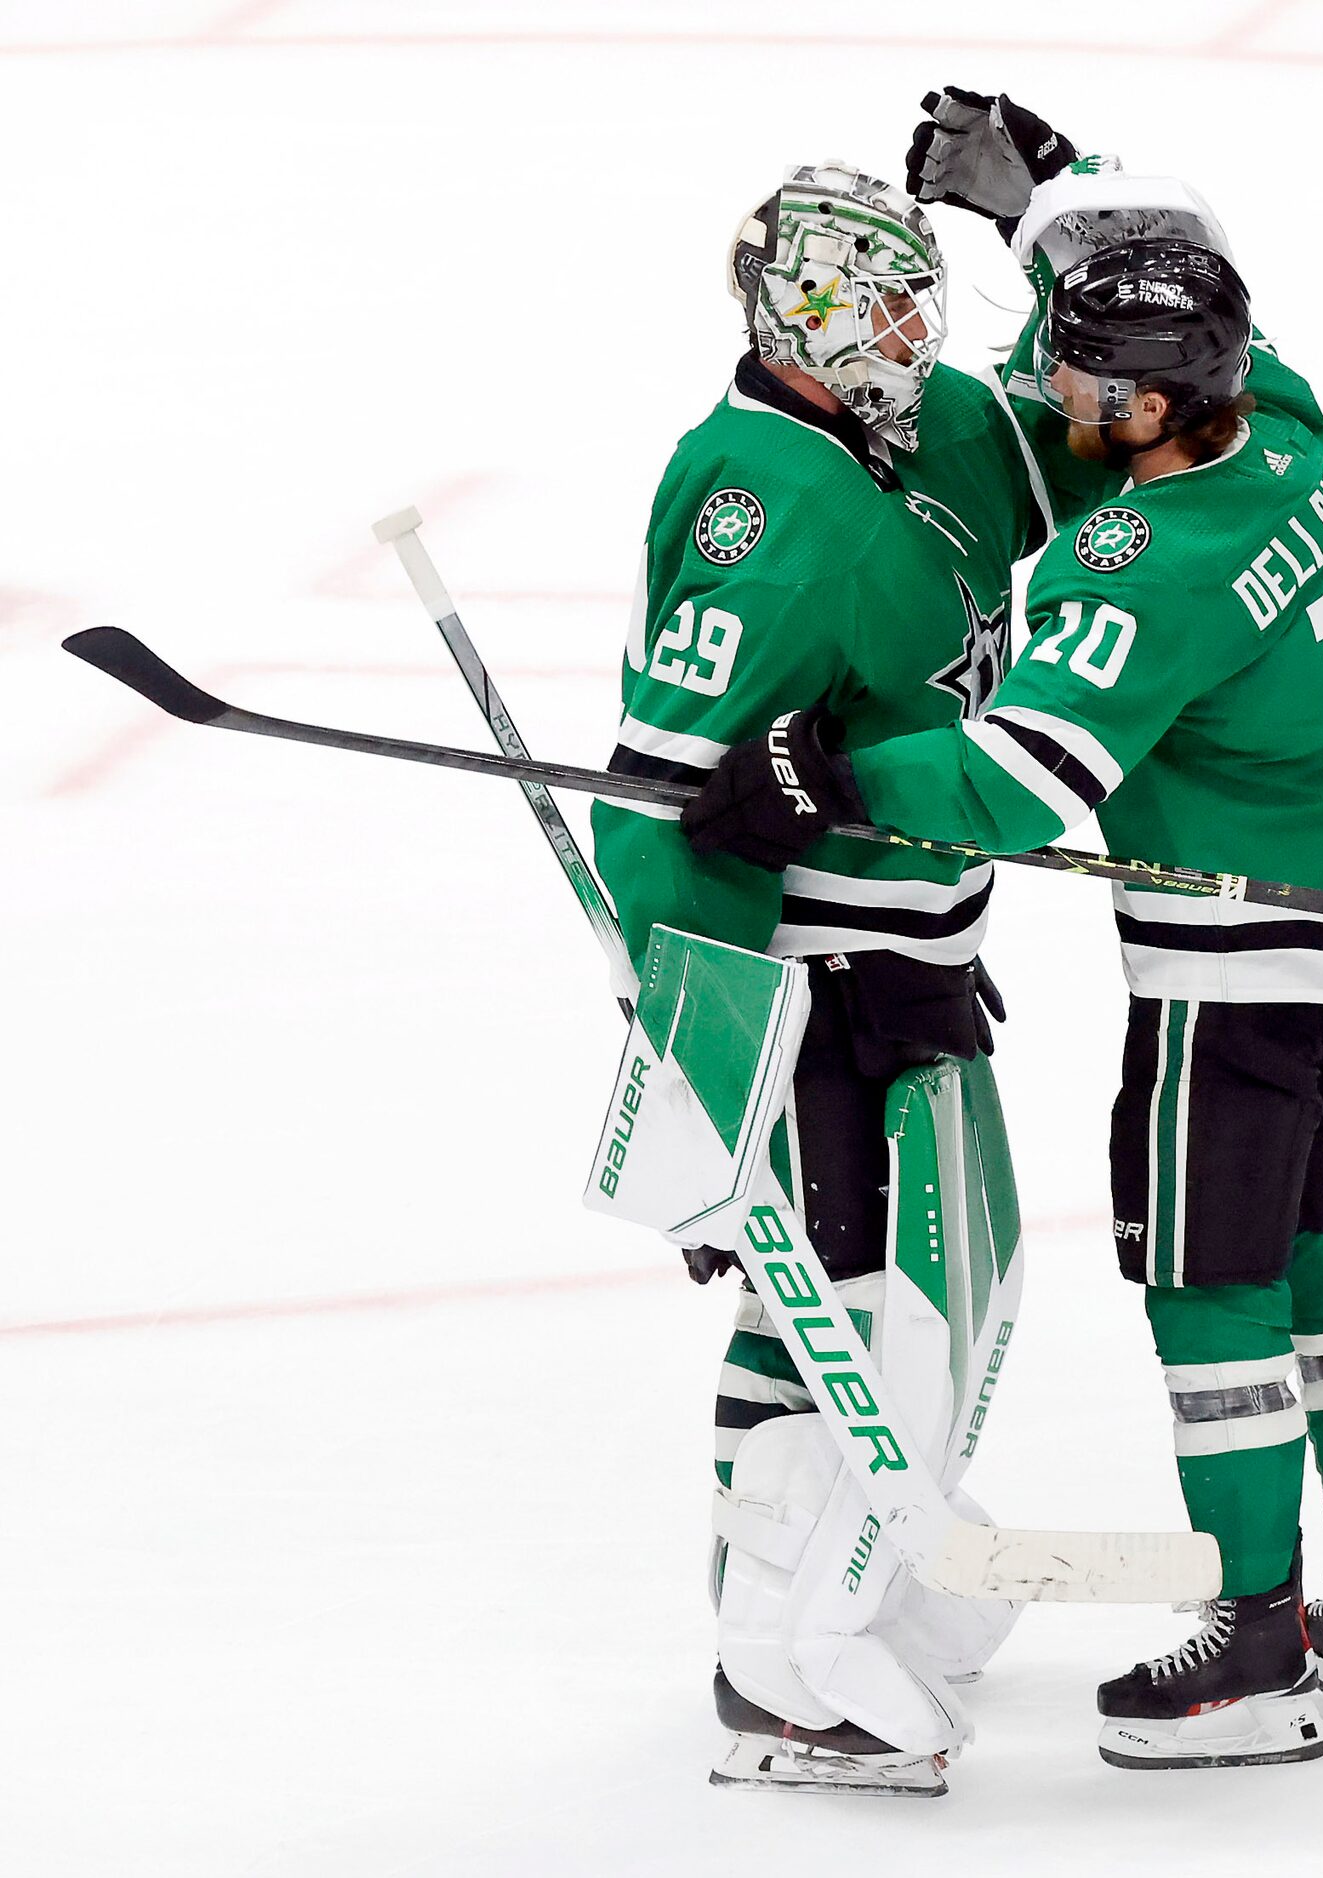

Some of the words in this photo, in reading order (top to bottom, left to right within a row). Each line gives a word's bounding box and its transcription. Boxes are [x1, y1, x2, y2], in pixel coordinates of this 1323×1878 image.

[1138, 279, 1184, 297] ENERGY
[1138, 291, 1194, 311] TRANSFER
[704, 493, 761, 526] DALLAS
[1084, 511, 1145, 534] DALLAS
[700, 533, 750, 560] STARS
[1080, 546, 1136, 567] STARS
[648, 600, 744, 697] 29
[1029, 600, 1137, 690] 10
[768, 709, 818, 816] AUER
[599, 1056, 651, 1199] BAUER
[744, 1204, 910, 1478] BAUER
[959, 1320, 1014, 1460] BAUER
[1117, 1730, 1149, 1745] CCM
